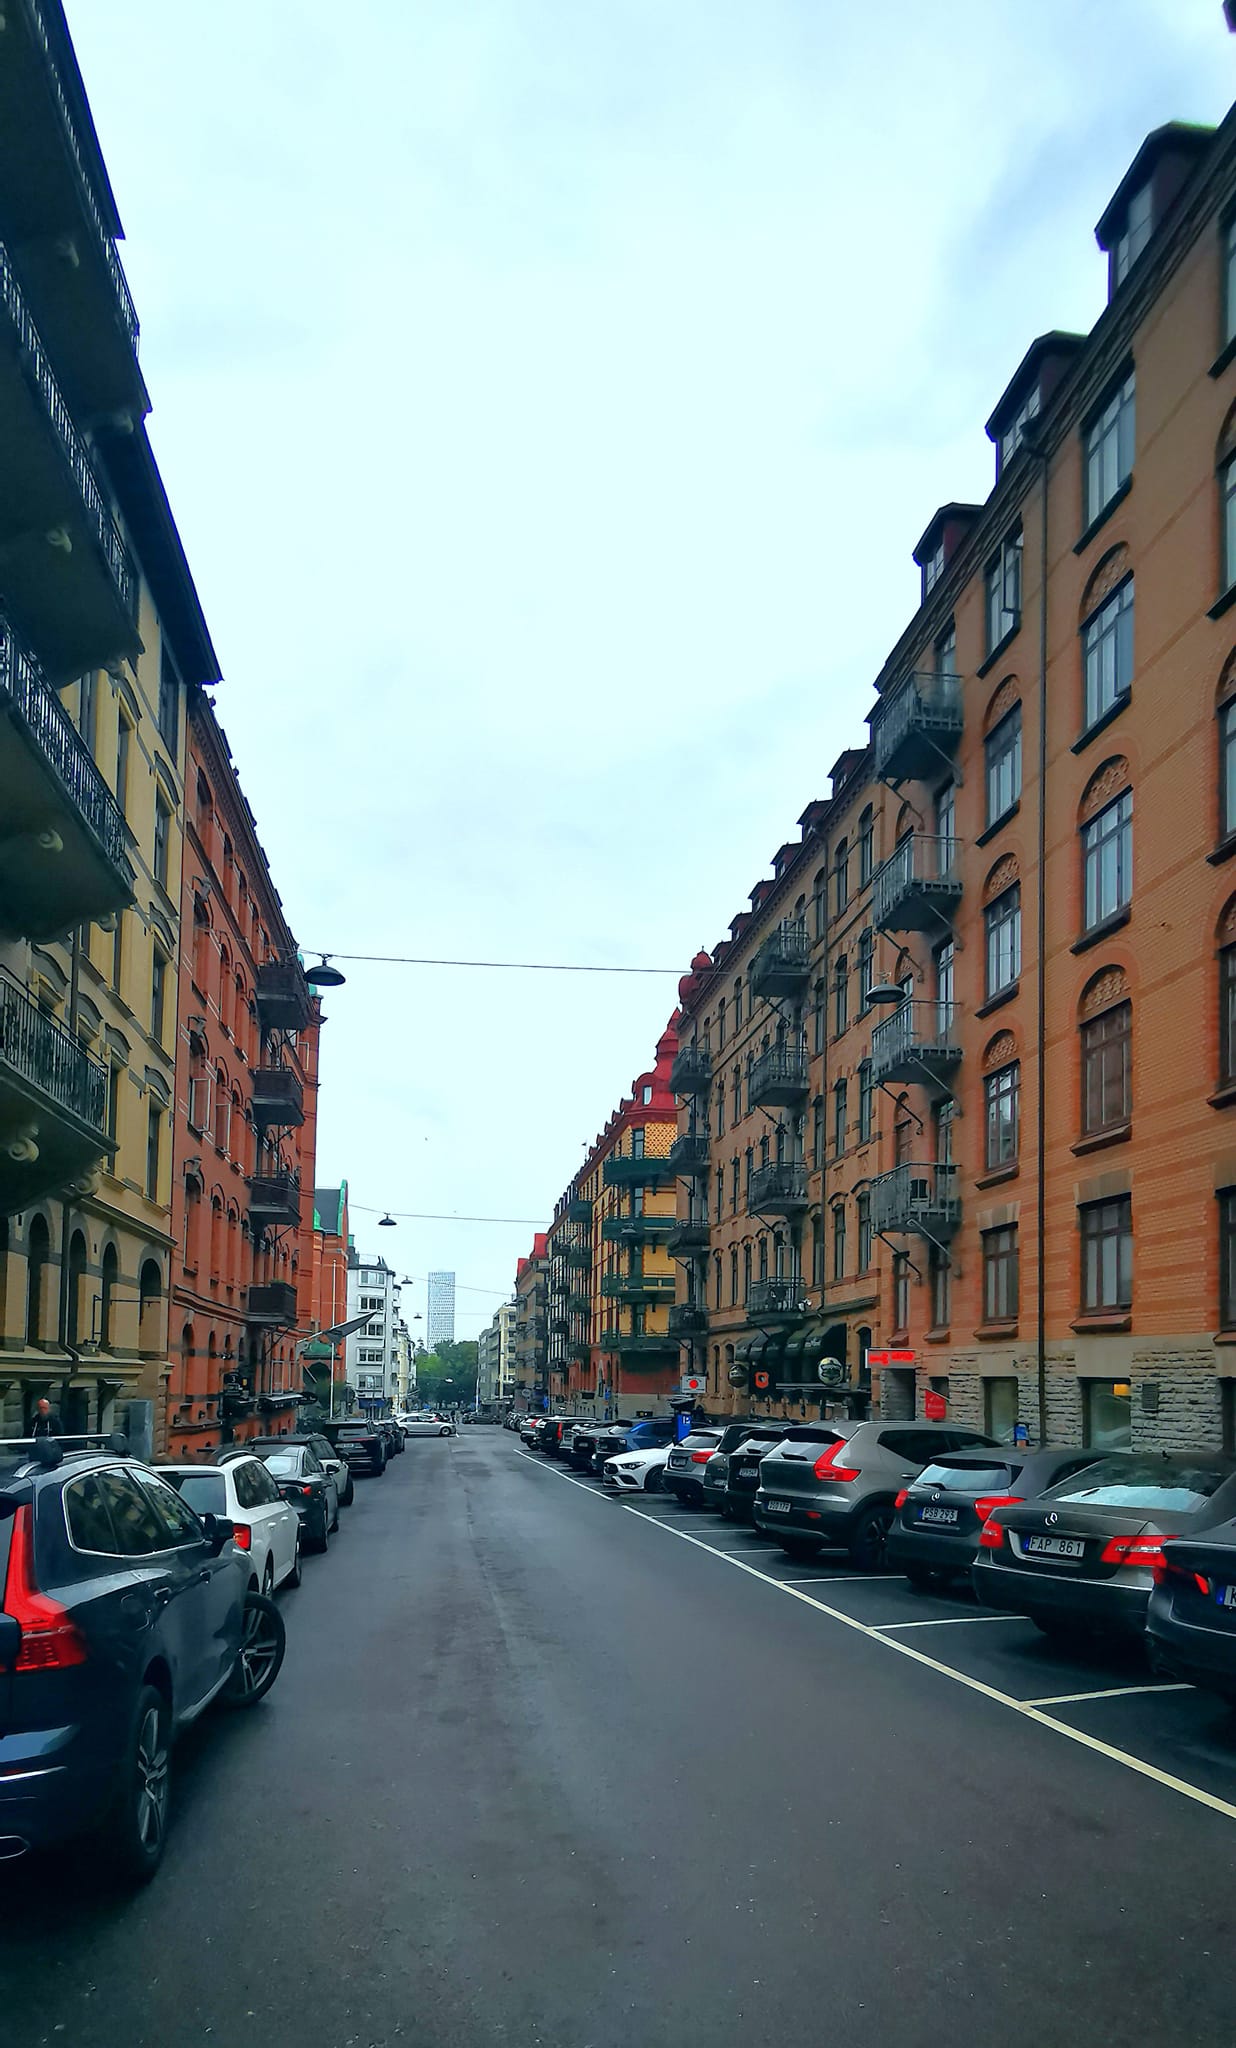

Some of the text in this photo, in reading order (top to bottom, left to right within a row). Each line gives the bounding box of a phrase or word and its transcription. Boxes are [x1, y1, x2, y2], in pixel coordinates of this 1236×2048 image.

[924, 1507, 939, 1518] PSB
[1030, 1537, 1081, 1555] FAP 861
